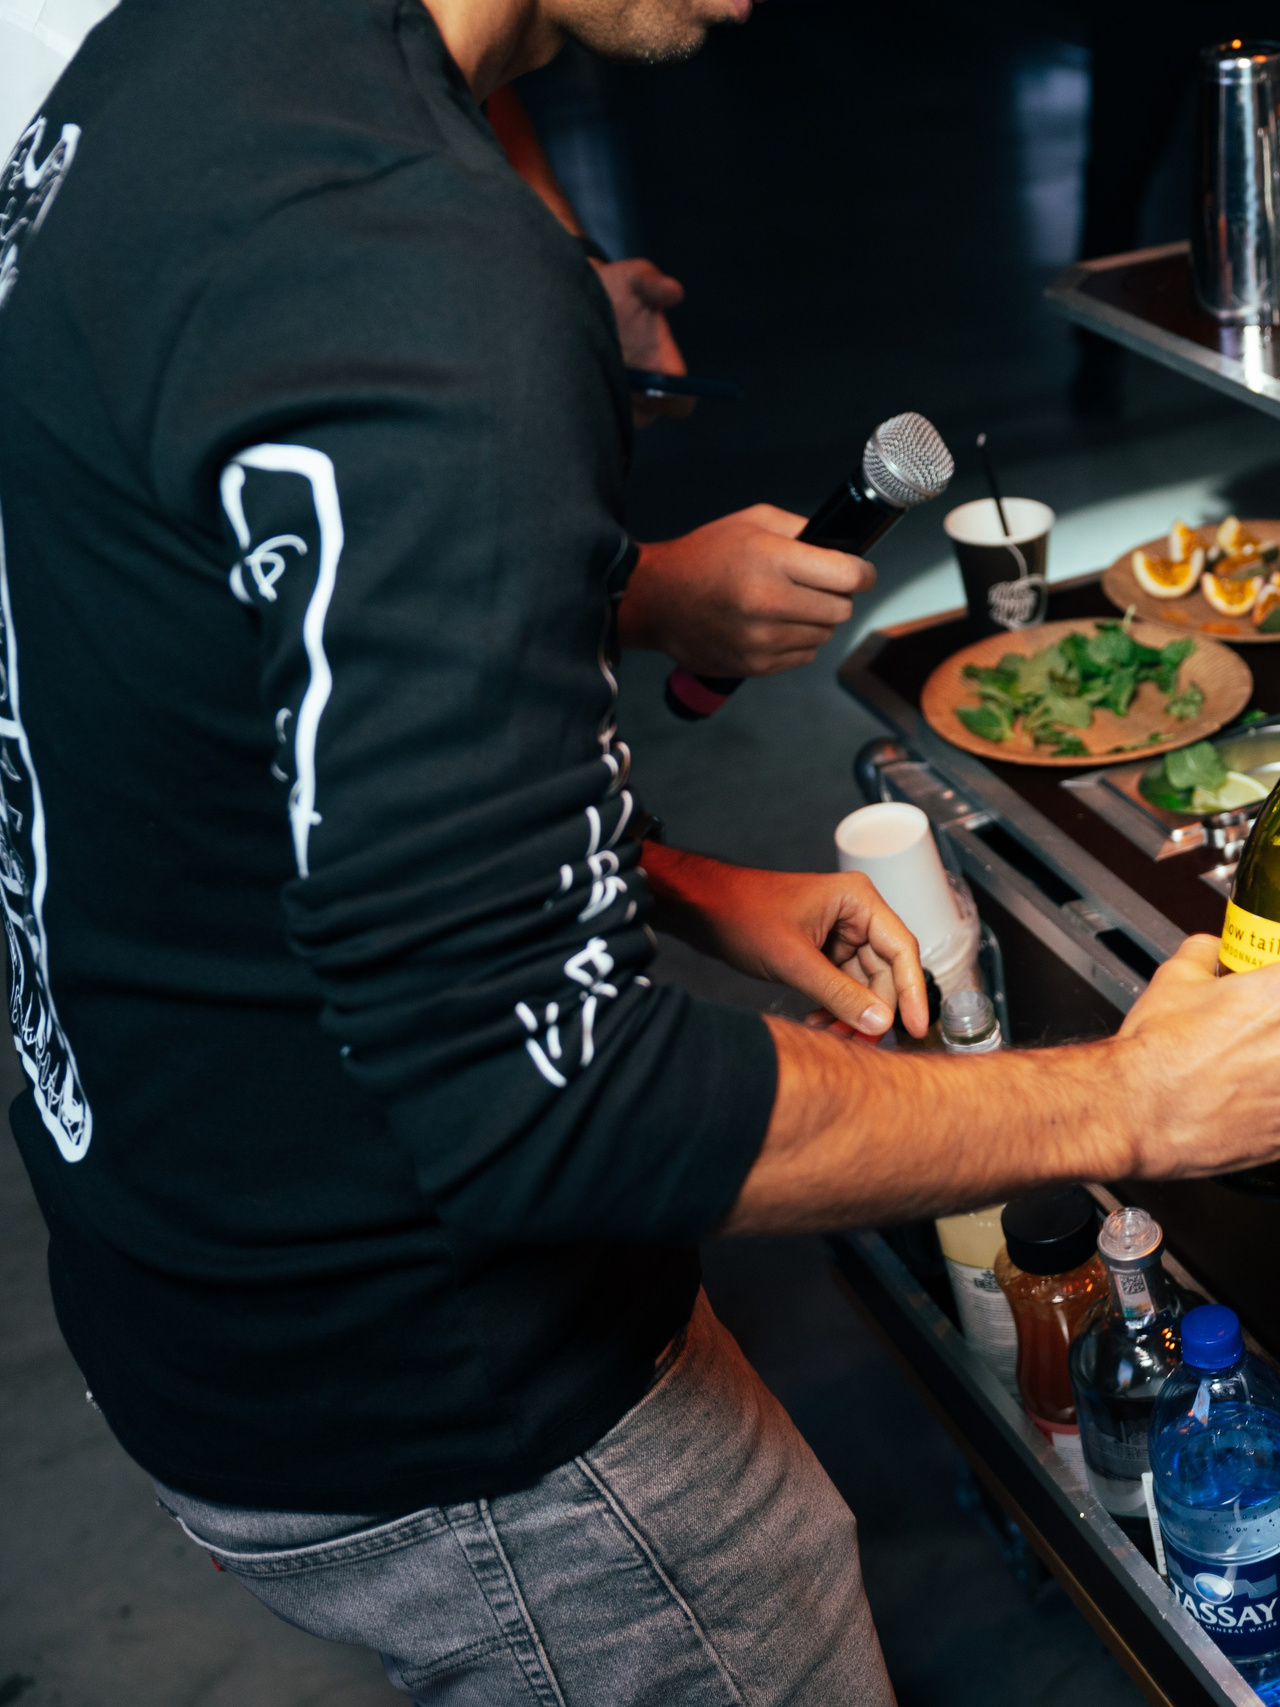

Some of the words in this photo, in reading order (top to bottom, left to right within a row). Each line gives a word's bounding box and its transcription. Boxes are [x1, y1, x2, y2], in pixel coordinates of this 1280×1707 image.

[1170, 1577, 1279, 1628] TASSAY
[1205, 1624, 1245, 1635] MINERAL
[1249, 1620, 1279, 1634] WATER
